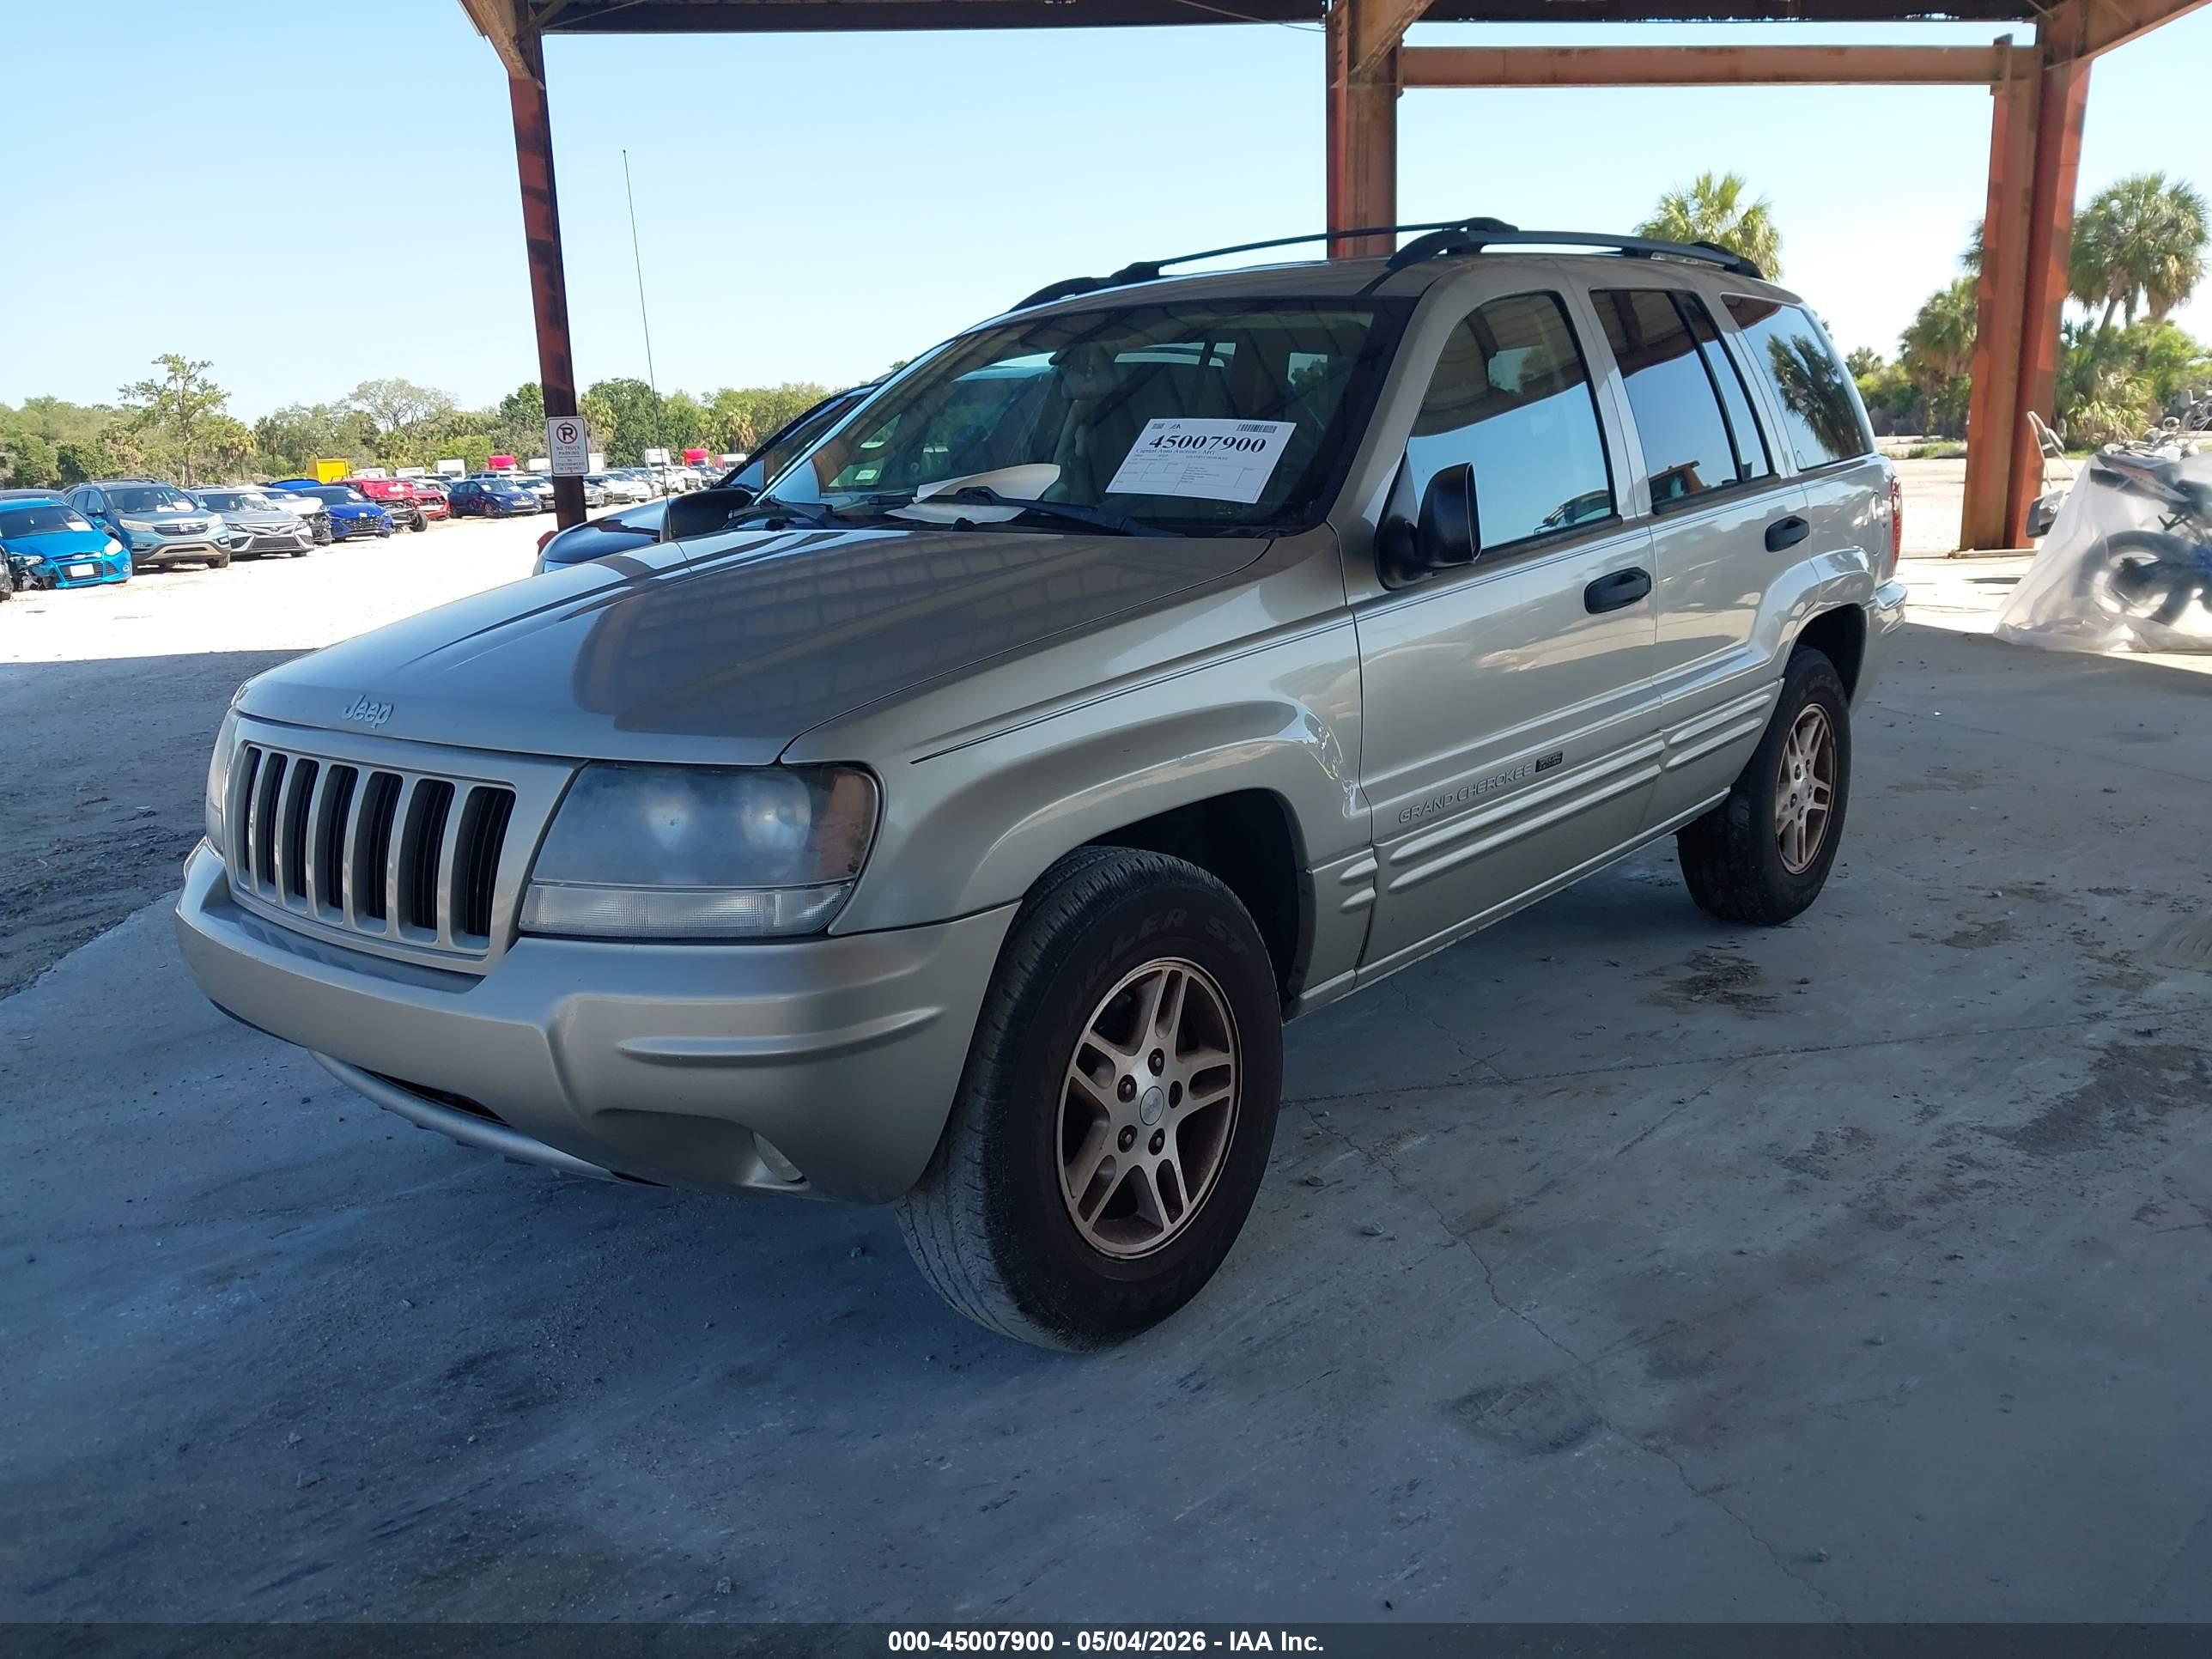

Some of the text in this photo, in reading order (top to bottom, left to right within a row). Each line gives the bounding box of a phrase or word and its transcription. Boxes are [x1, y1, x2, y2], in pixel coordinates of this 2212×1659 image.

[1149, 434, 1267, 453] 45007900
[342, 694, 395, 729] Jeep
[1398, 763, 1534, 824] GRAND CHEROKEE
